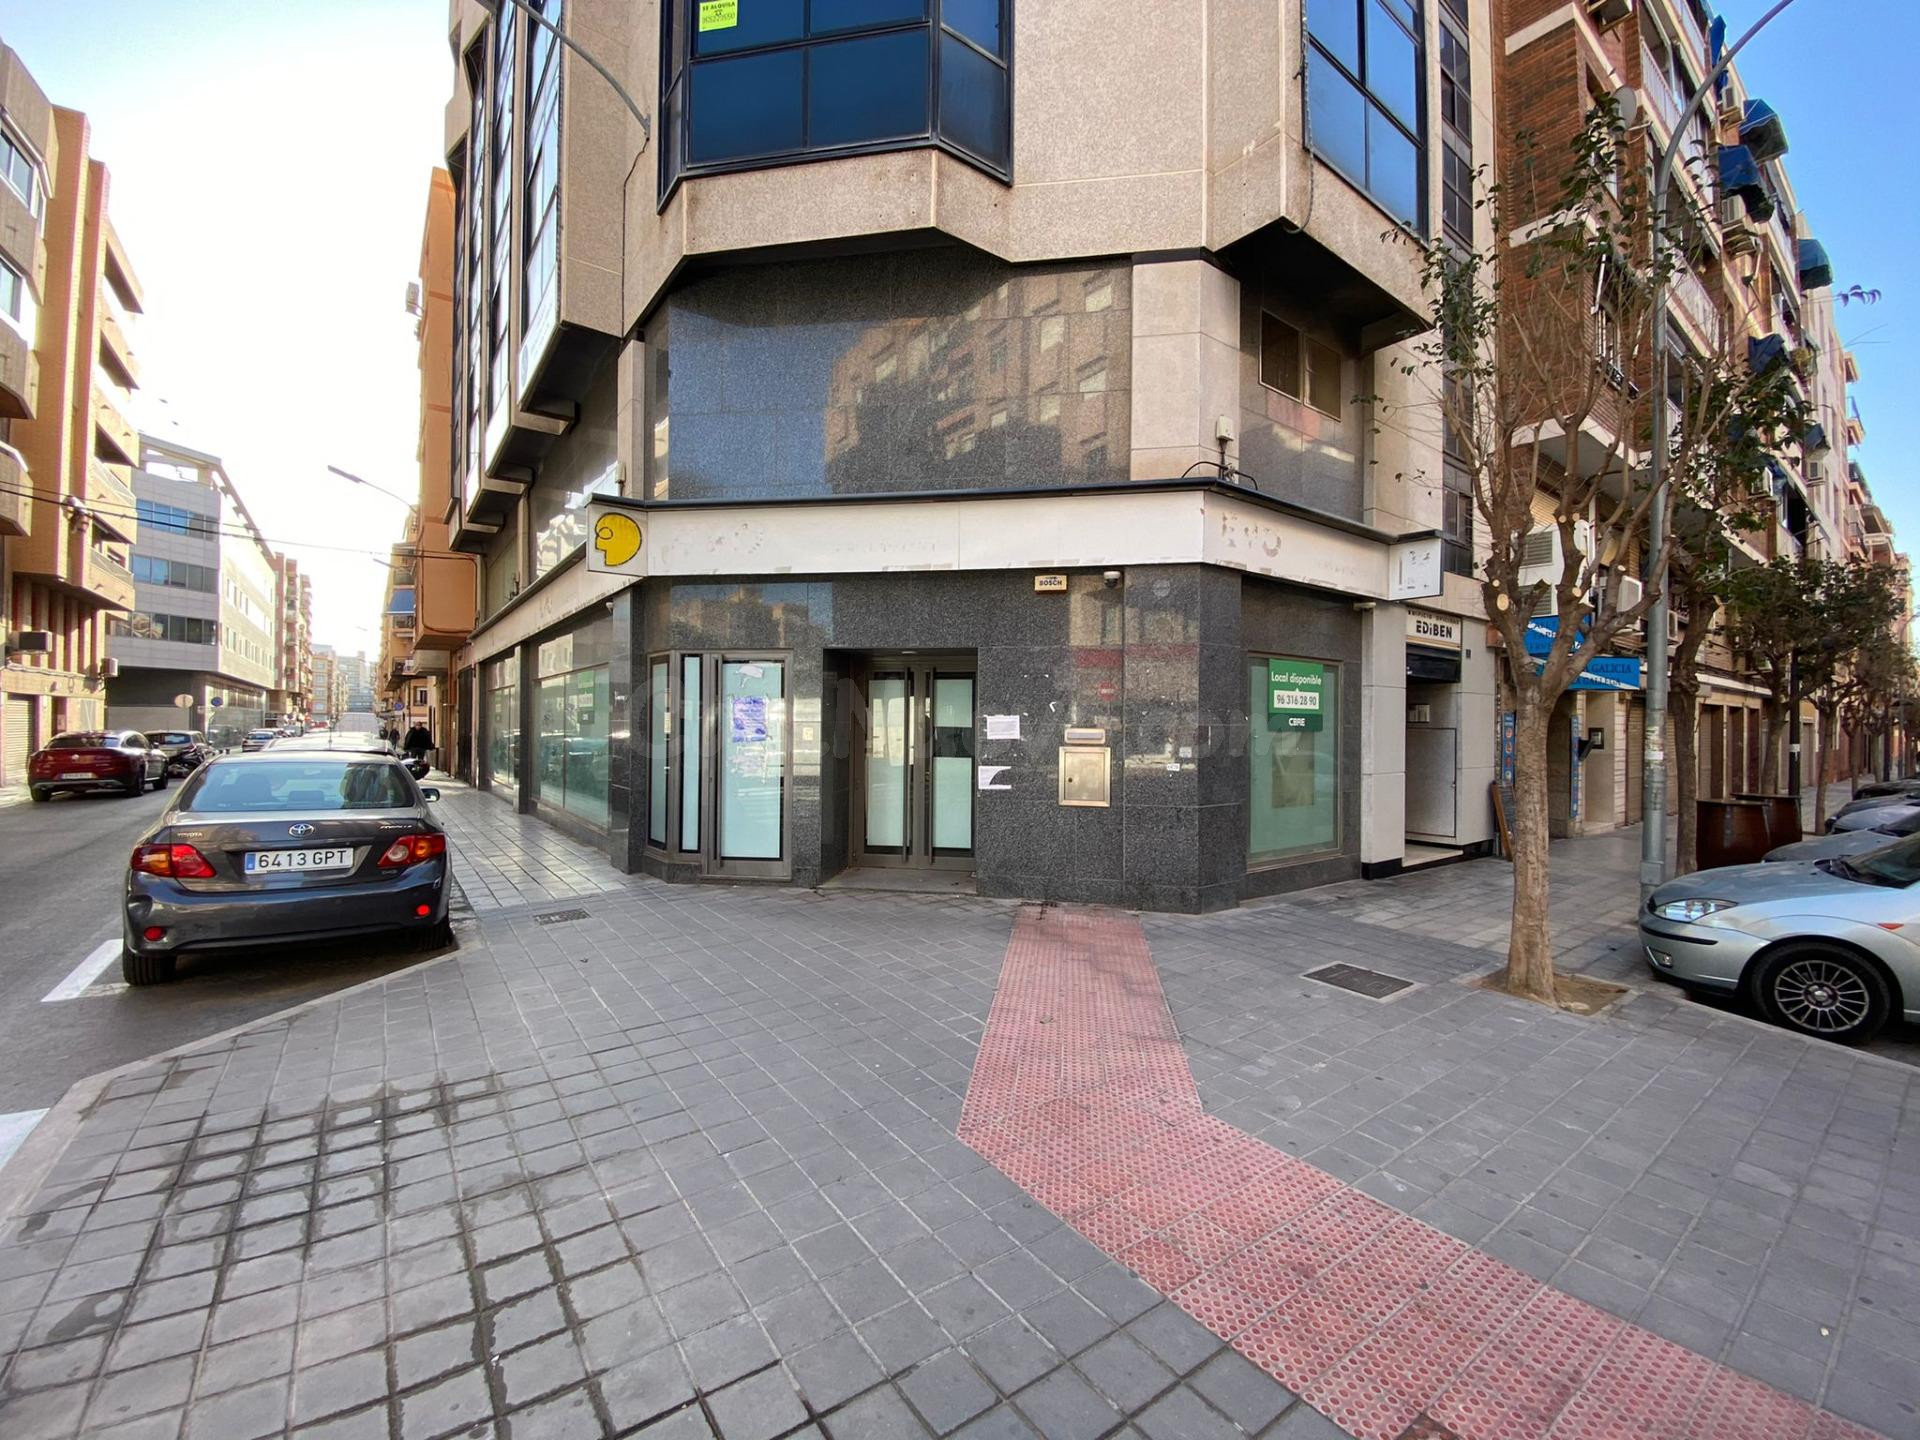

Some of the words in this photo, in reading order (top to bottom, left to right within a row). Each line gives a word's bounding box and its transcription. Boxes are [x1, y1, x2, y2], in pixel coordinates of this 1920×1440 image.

[1592, 663, 1632, 673] GALICIA
[1271, 671, 1288, 682] Local
[1290, 673, 1322, 686] disponible
[1276, 694, 1285, 704] 96
[1287, 695, 1298, 705] 316
[1300, 696, 1308, 705] 28
[1309, 696, 1317, 706] 90
[259, 853, 307, 869] 6413
[312, 850, 347, 865] GPT
